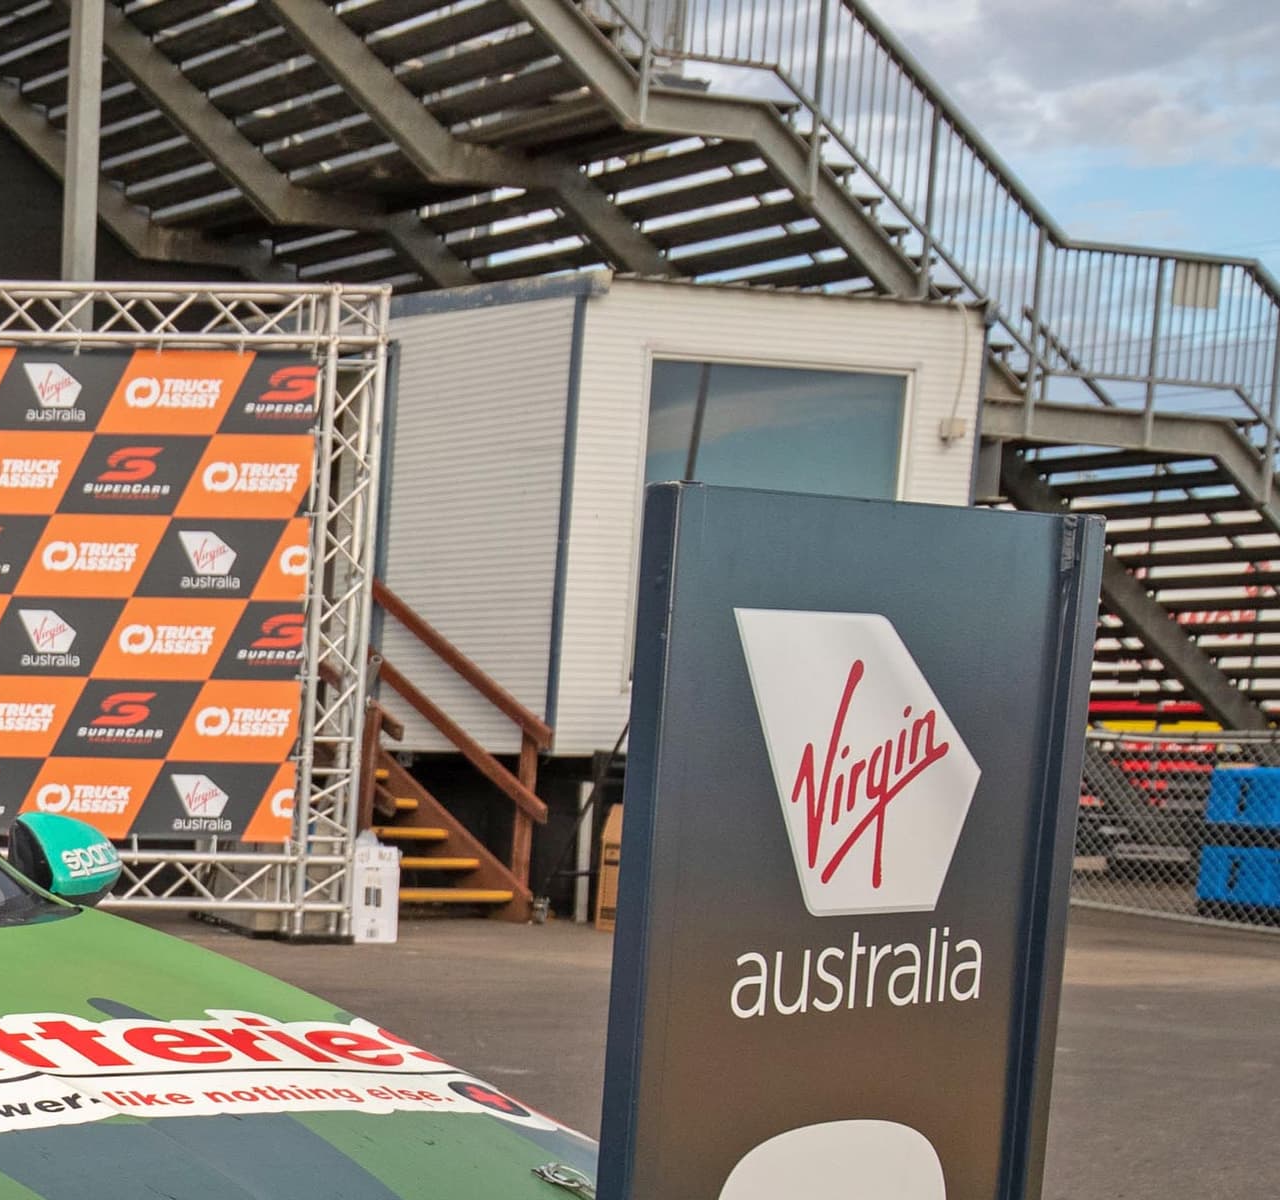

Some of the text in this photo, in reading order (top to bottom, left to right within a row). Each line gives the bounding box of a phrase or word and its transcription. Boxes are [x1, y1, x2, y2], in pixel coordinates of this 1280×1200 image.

[37, 371, 73, 401] Virgin
[26, 408, 85, 422] australia
[245, 403, 314, 414] SUPERCA
[2, 460, 61, 473] TRUCK
[241, 463, 300, 478] TRUCK
[84, 484, 170, 495] SUPERCARS
[235, 478, 297, 493] ASSIST
[193, 541, 228, 570] Virgin
[181, 575, 240, 590] australia
[33, 617, 67, 648] Virgin
[156, 626, 215, 640] TRUCK
[151, 640, 213, 655] ASSIST
[21, 653, 80, 667] australia
[233, 709, 291, 723] TRUCK
[78, 727, 163, 739] SUPERCARS
[226, 723, 290, 737] ASSIST
[792, 660, 949, 888] Virgin
[73, 785, 131, 799] TRUCK
[185, 785, 220, 814] Virgin
[67, 799, 129, 815] ASSIST
[173, 818, 231, 832] australia
[62, 842, 116, 876] spar
[731, 926, 982, 1018] australia
[102, 1088, 195, 1106] like
[202, 1082, 355, 1104] nothing
